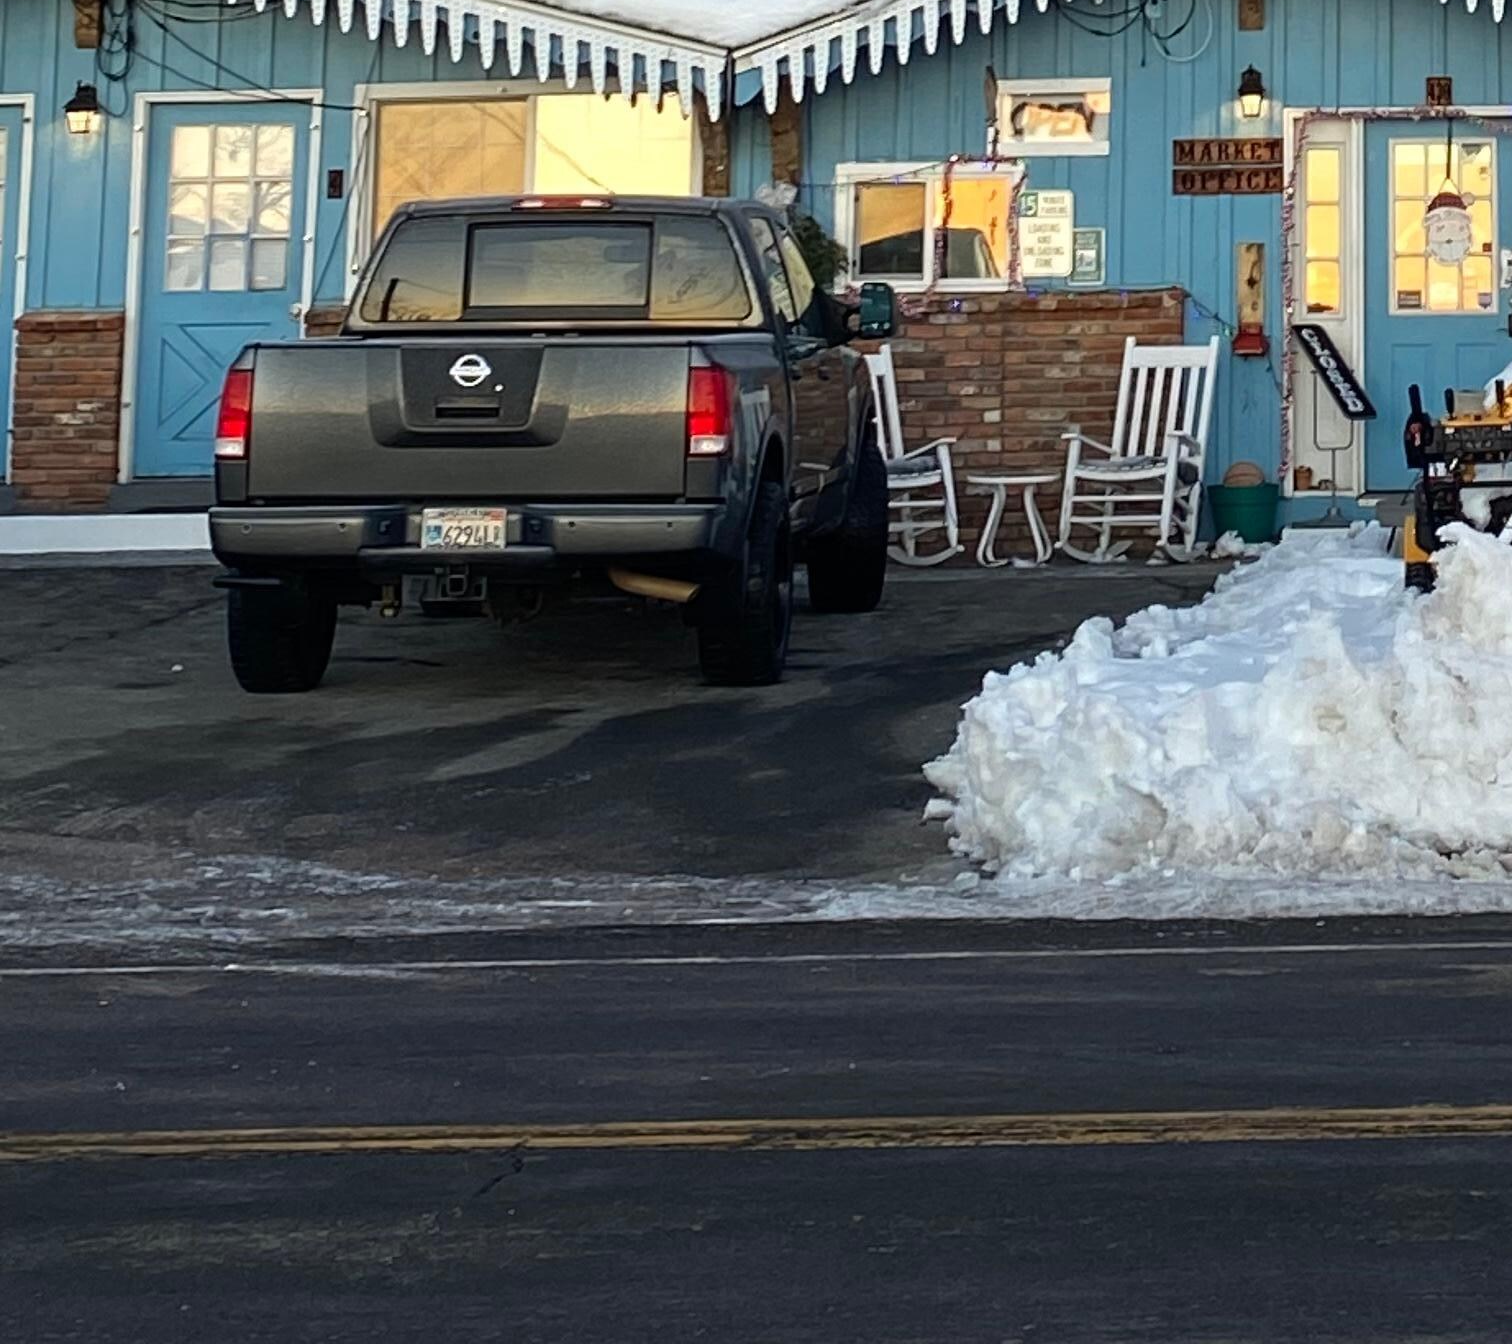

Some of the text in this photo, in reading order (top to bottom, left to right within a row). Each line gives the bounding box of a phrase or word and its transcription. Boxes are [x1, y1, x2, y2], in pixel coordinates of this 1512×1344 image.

[1177, 141, 1281, 162] MARKET
[1180, 171, 1282, 191] OFFICE
[1020, 195, 1036, 215] 15
[1301, 328, 1364, 412] CLOSED
